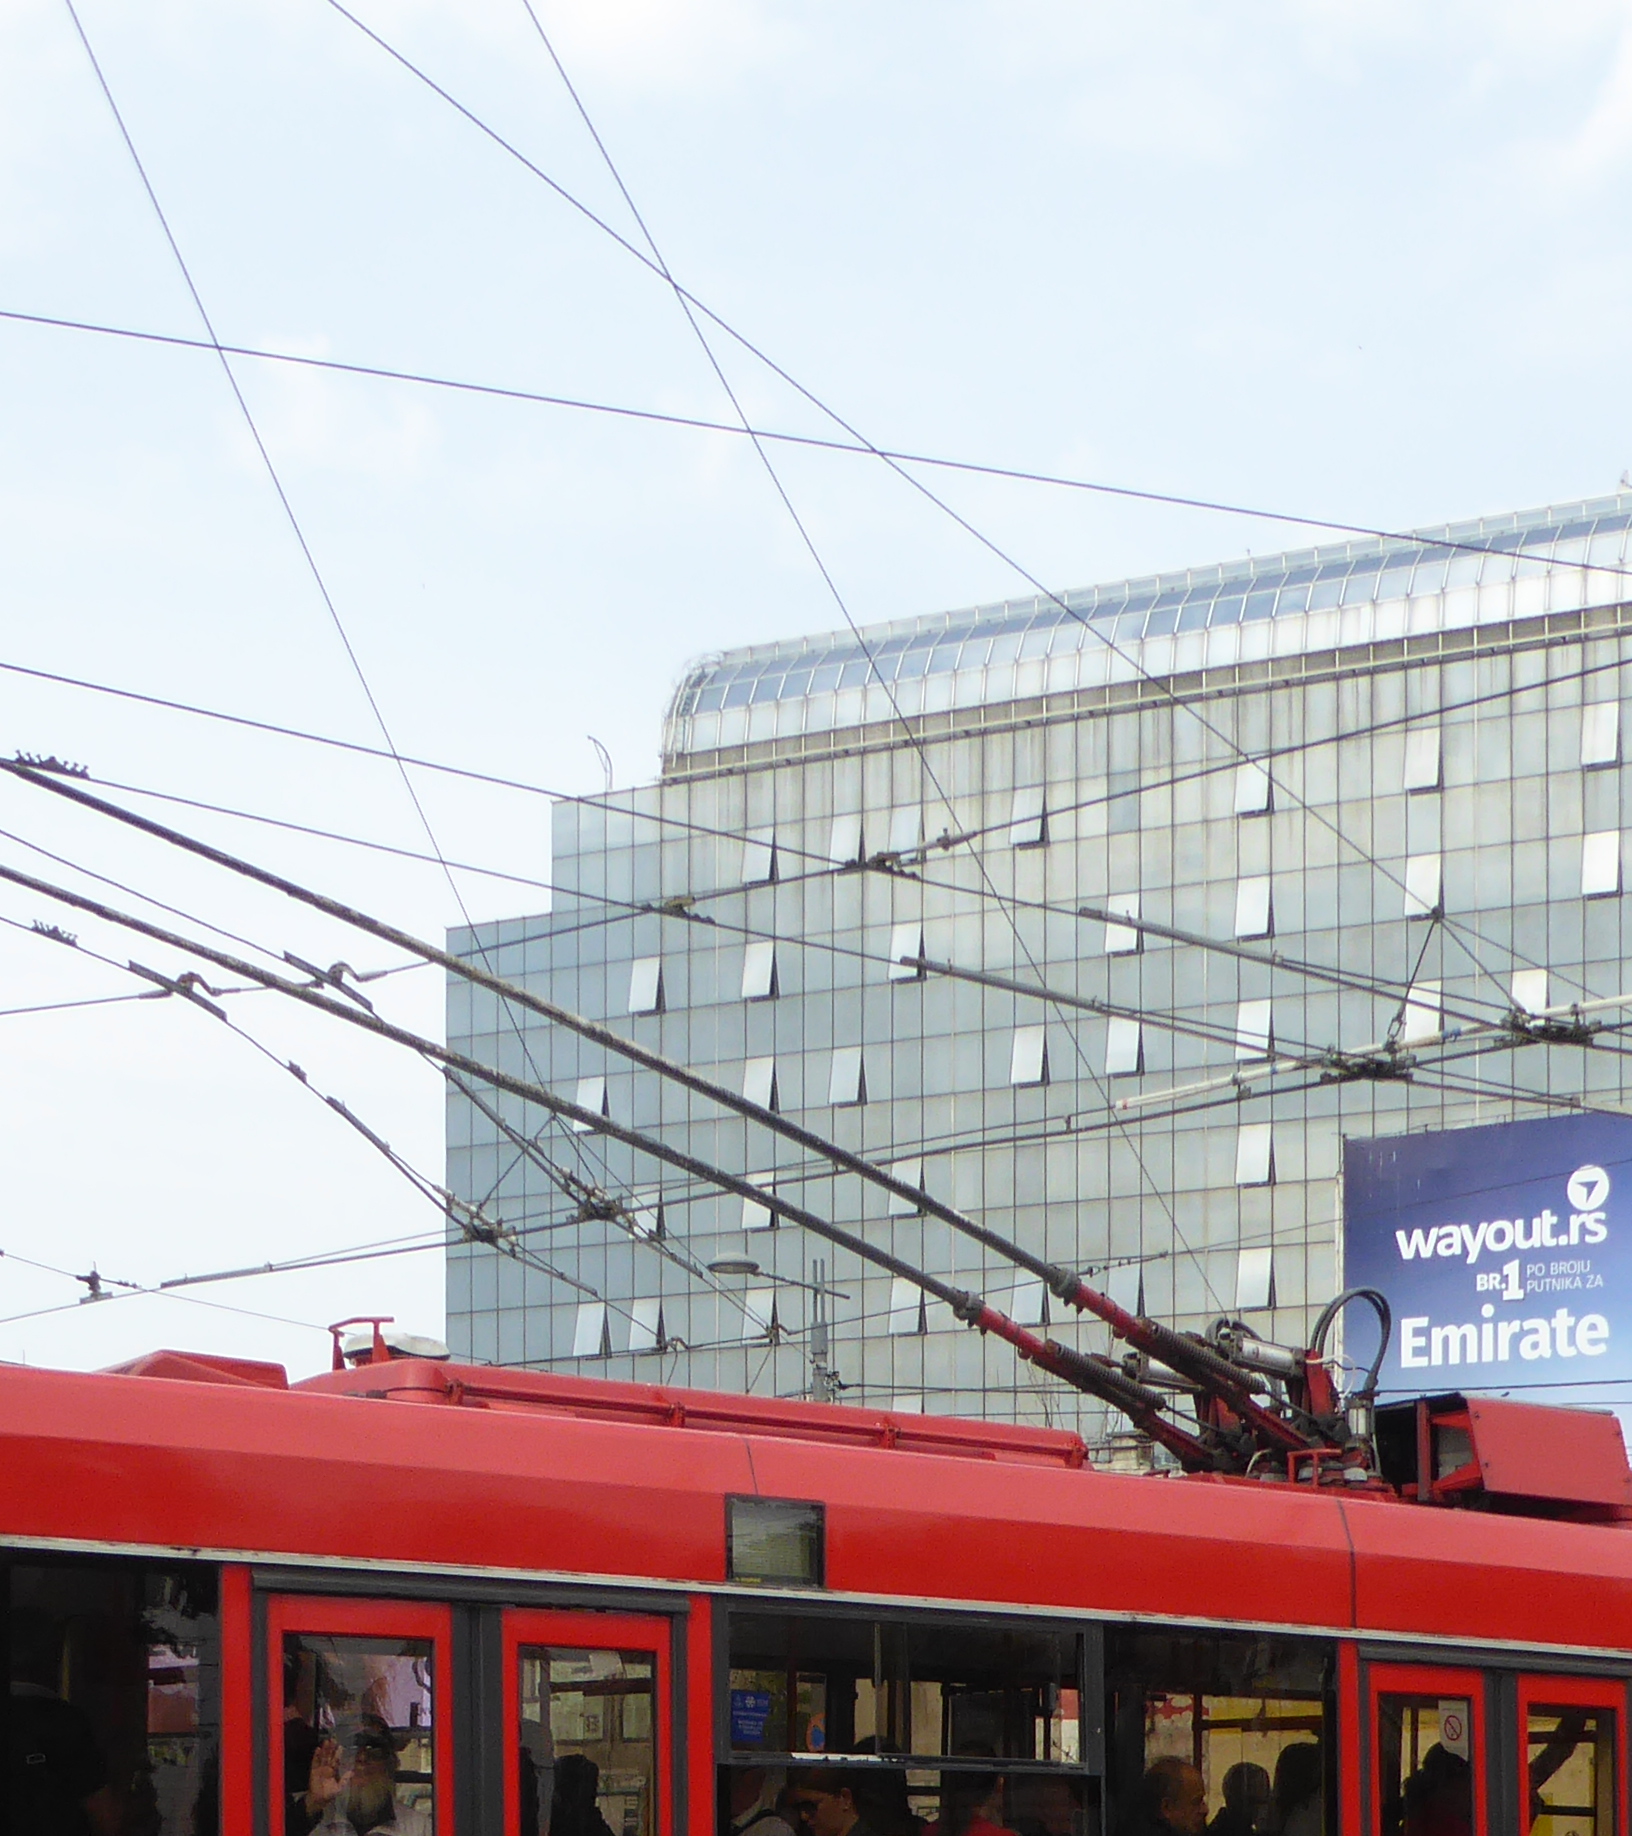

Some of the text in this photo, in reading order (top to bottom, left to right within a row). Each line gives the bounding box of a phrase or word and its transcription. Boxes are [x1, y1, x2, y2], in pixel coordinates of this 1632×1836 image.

[1395, 1209, 1608, 1264] wayout.rs
[1526, 1260, 1591, 1278] PO BROJU
[1526, 1274, 1604, 1293] PUTNIKA ZA
[1400, 1303, 1610, 1368] Emirate
